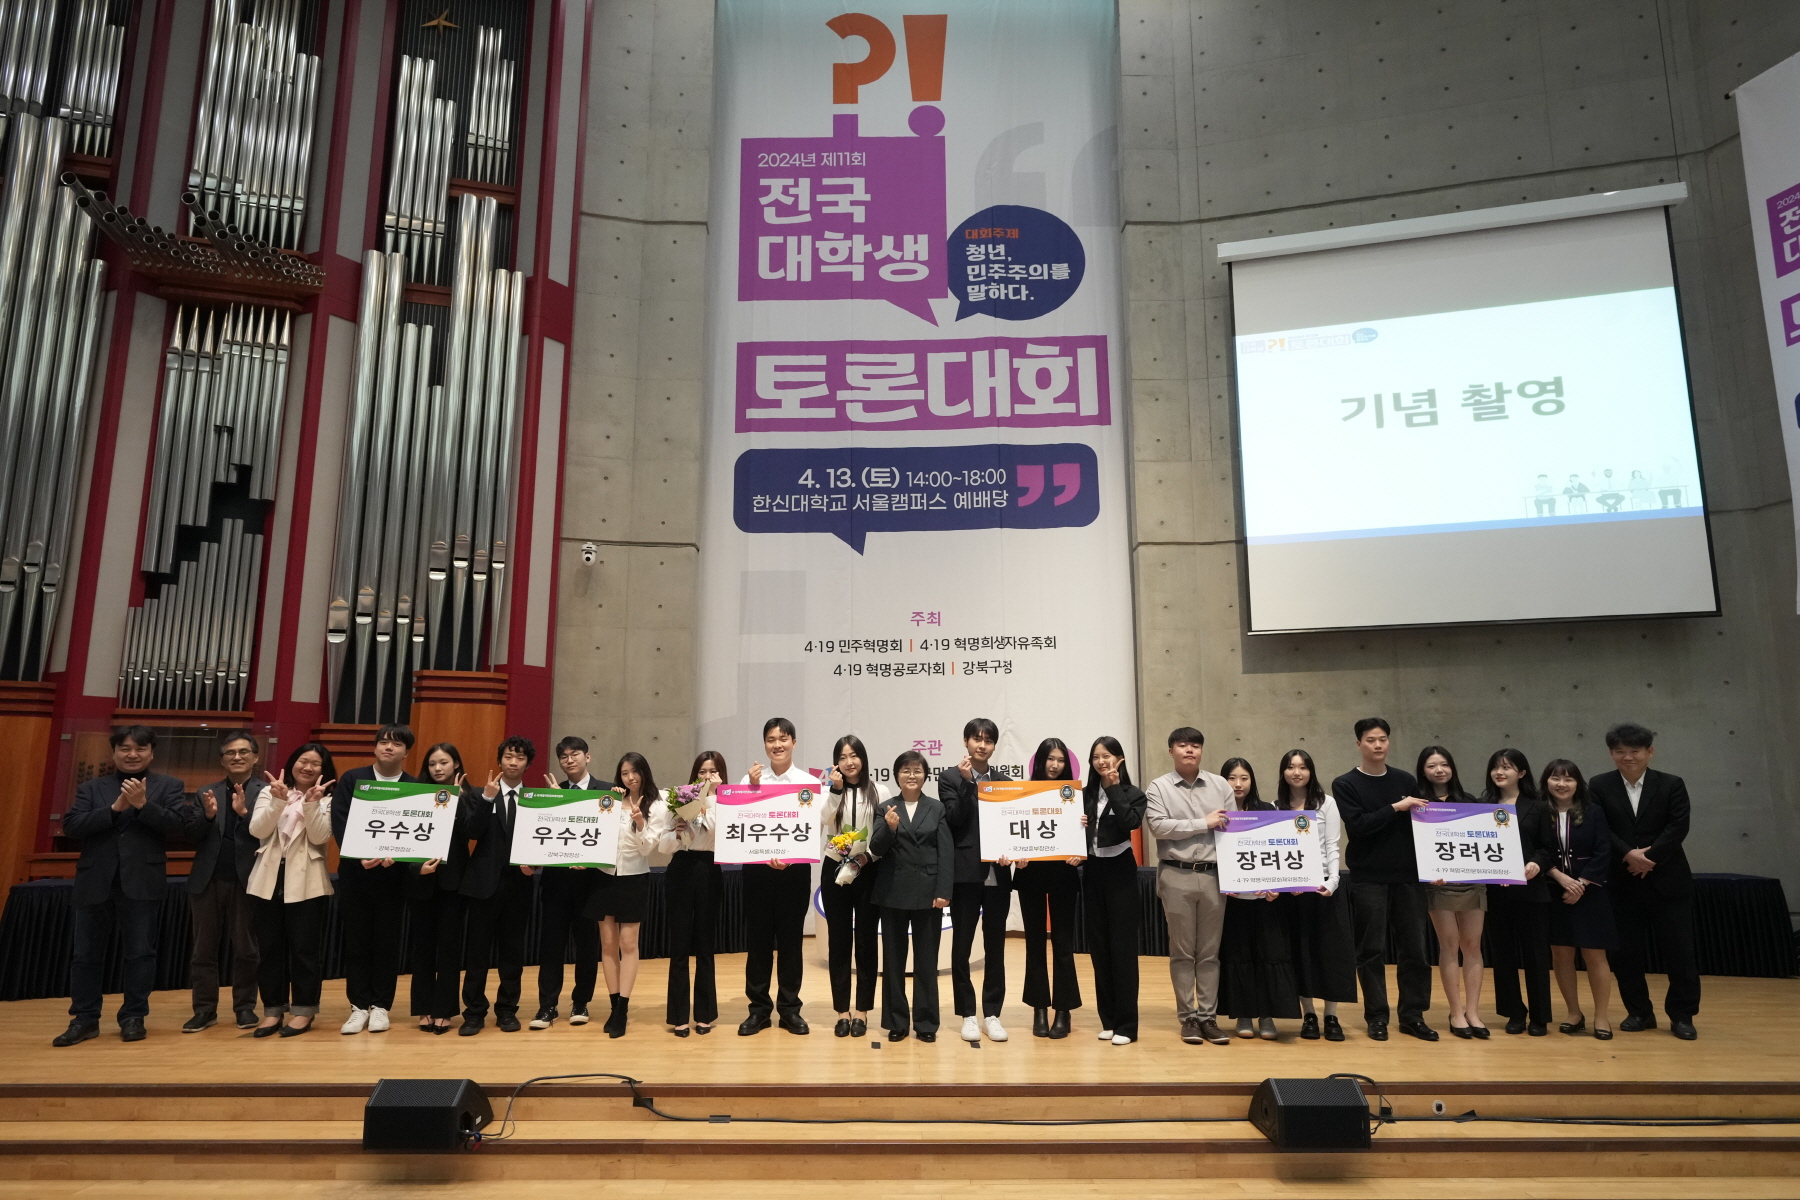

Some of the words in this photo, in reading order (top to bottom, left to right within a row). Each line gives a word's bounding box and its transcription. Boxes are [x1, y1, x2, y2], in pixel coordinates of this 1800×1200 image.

[757, 152, 816, 168] 2024년
[821, 151, 866, 167] 제11회
[758, 177, 871, 225] 전국
[965, 228, 1019, 239] 대회주제
[757, 231, 930, 282] 대학생
[965, 244, 1012, 261] 청년,
[966, 263, 1071, 281] 민주주의를
[966, 282, 1034, 302] 말하다.
[745, 343, 1100, 423] 토론대회
[1340, 388, 1439, 429] 기념
[1460, 375, 1567, 422] 촬영
[797, 468, 820, 488] 4.
[826, 468, 856, 488] 13.
[861, 466, 900, 489] (토)
[906, 468, 1007, 488] 14:00~18:00
[752, 494, 847, 513] 한신대학교
[852, 491, 947, 512] 서울캠퍼스
[953, 489, 1009, 510] 예배당
[910, 611, 941, 627] 주최
[804, 640, 835, 653] 4·19
[838, 638, 903, 654] 민주혁명회
[920, 638, 950, 651] 4·19
[954, 635, 1057, 651] 혁명희생자유족회
[833, 663, 862, 677] 4·19
[866, 662, 945, 677] 혁명공로자회
[912, 739, 943, 756] 주관
[402, 810, 433, 818] 토론대회
[568, 815, 598, 823] 토론대회
[1032, 807, 1062, 815] 토론대회
[365, 820, 434, 841] 우수상
[532, 827, 601, 846] 우수상
[725, 822, 812, 842] 최우수상
[1467, 830, 1498, 839] 토론대회
[1268, 838, 1298, 846] 토론대회
[1434, 841, 1504, 862] 장려상
[1236, 850, 1304, 870] 장려상
